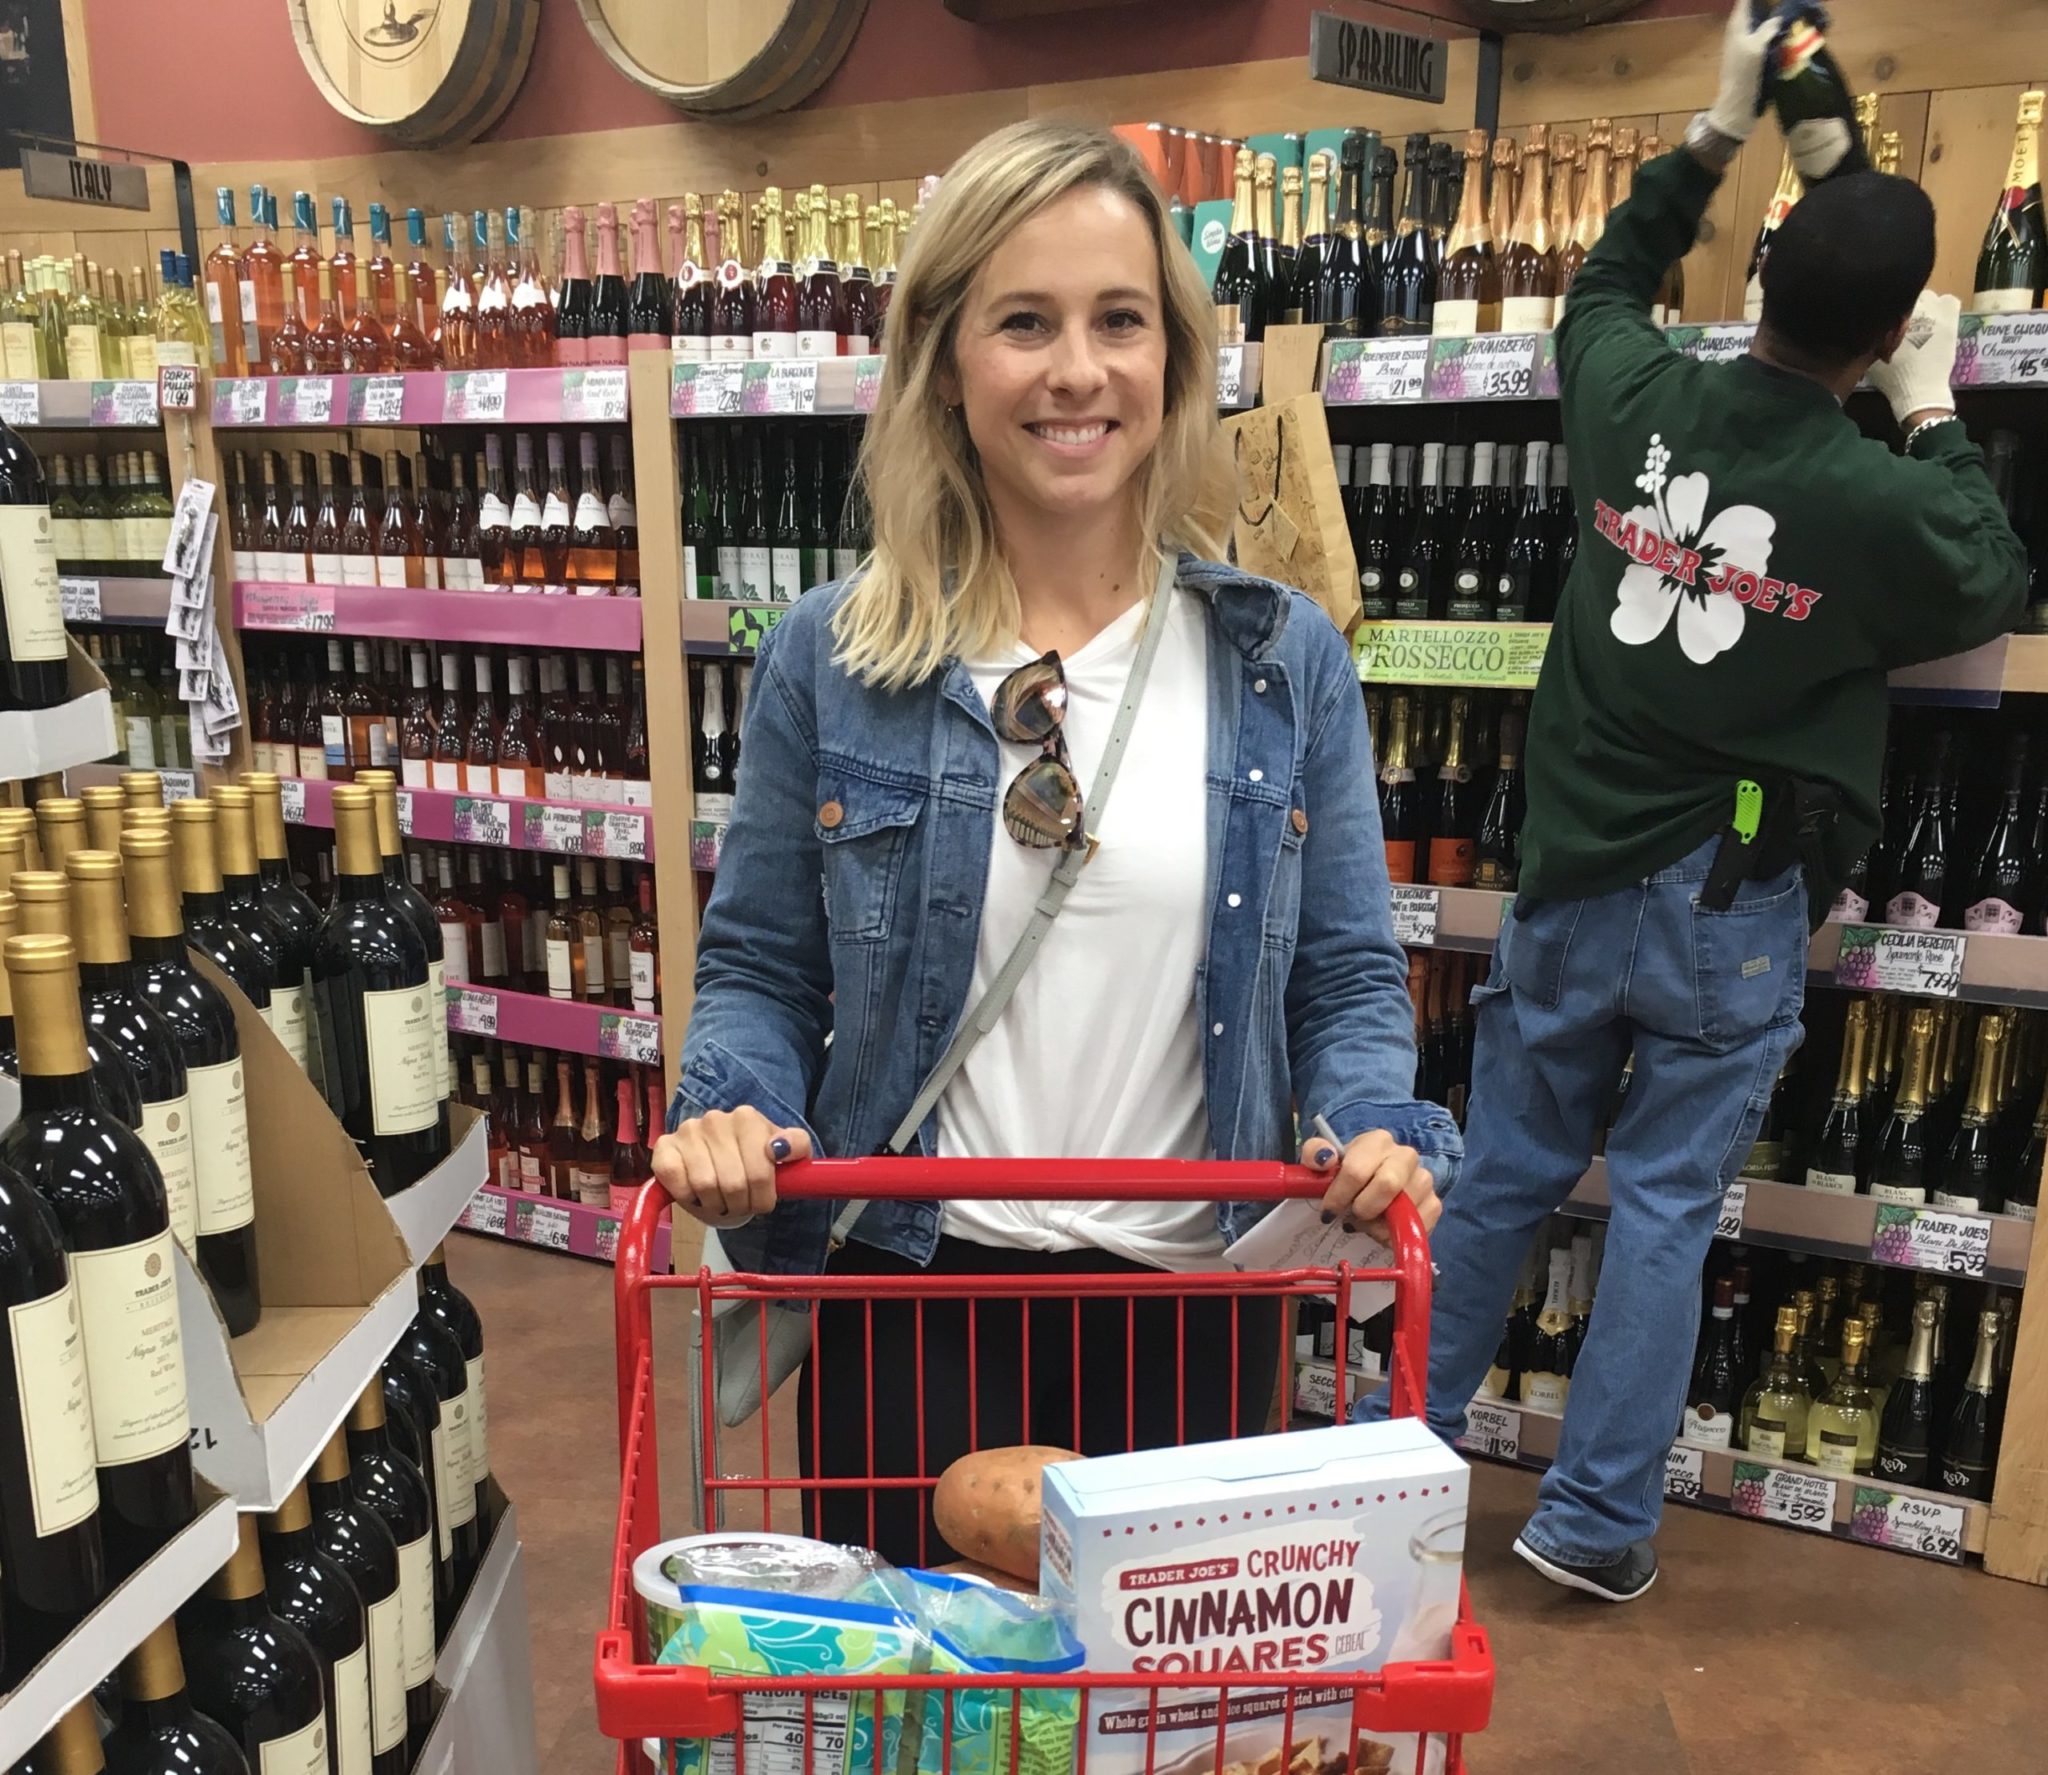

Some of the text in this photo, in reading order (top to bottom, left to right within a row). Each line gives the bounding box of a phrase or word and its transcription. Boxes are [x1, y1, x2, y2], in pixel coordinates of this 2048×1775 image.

[1338, 20, 1434, 94] SPARKLING
[69, 160, 112, 202] ITALY
[1981, 324, 2011, 336] VEUVE
[1463, 337, 1535, 355] SCHRAMSBERG
[1698, 336, 1735, 351] CHARLES
[2001, 335, 2022, 344] BRUT
[1363, 350, 1427, 362] ROEDERER ESTATE
[1981, 342, 2047, 361] Champagne
[164, 371, 191, 381] CORK
[1376, 363, 1407, 376] Brut
[163, 381, 195, 391] PULLER
[1483, 368, 1532, 396] $35.99
[790, 388, 814, 411] $11.99
[1594, 499, 1823, 621] TRADER JOE'S
[1369, 629, 1501, 645] MARTELLOZZO
[1358, 643, 1504, 672] PROSSECCO
[1412, 922, 1436, 938] $9.99
[1882, 934, 1956, 951] CECILIA BERETTA
[1915, 1218, 1958, 1235] TRADER
[1914, 1234, 1943, 1247] Blanc
[1942, 1250, 1987, 1274] $5.99
[135, 1284, 160, 1298] TRADER
[1530, 1389, 1559, 1399] KORBEL
[1470, 1409, 1508, 1426] KORBEL
[1687, 1418, 1727, 1433] Prosecco
[1475, 1421, 1501, 1434] Brut
[1880, 1456, 1907, 1473] RSVP
[1775, 1473, 1828, 1491] GRAND HOTEL
[1943, 1470, 1970, 1486] RSVP
[1772, 1482, 1793, 1492] BLANC
[1775, 1490, 1791, 1499] Vino
[1891, 1515, 1957, 1537] Sparkling Brut
[1916, 1535, 1958, 1556] $6.99
[1129, 1540, 1361, 1586] TRADER JOE'S CRUNCHY
[1124, 1578, 1354, 1647] CINNAMON
[1132, 1631, 1365, 1674] SQUARES CEREAL
[1104, 1714, 1136, 1730] Whole
[1138, 1710, 1167, 1728] grin
[1169, 1708, 1199, 1723] wheat
[1201, 1705, 1219, 1720] and
[1226, 1702, 1242, 1716] ice
[1243, 1697, 1280, 1716] squares
[1281, 1692, 1313, 1710] dsted
[1315, 1687, 1338, 1704] with
[785, 1732, 844, 1749] 40 70
